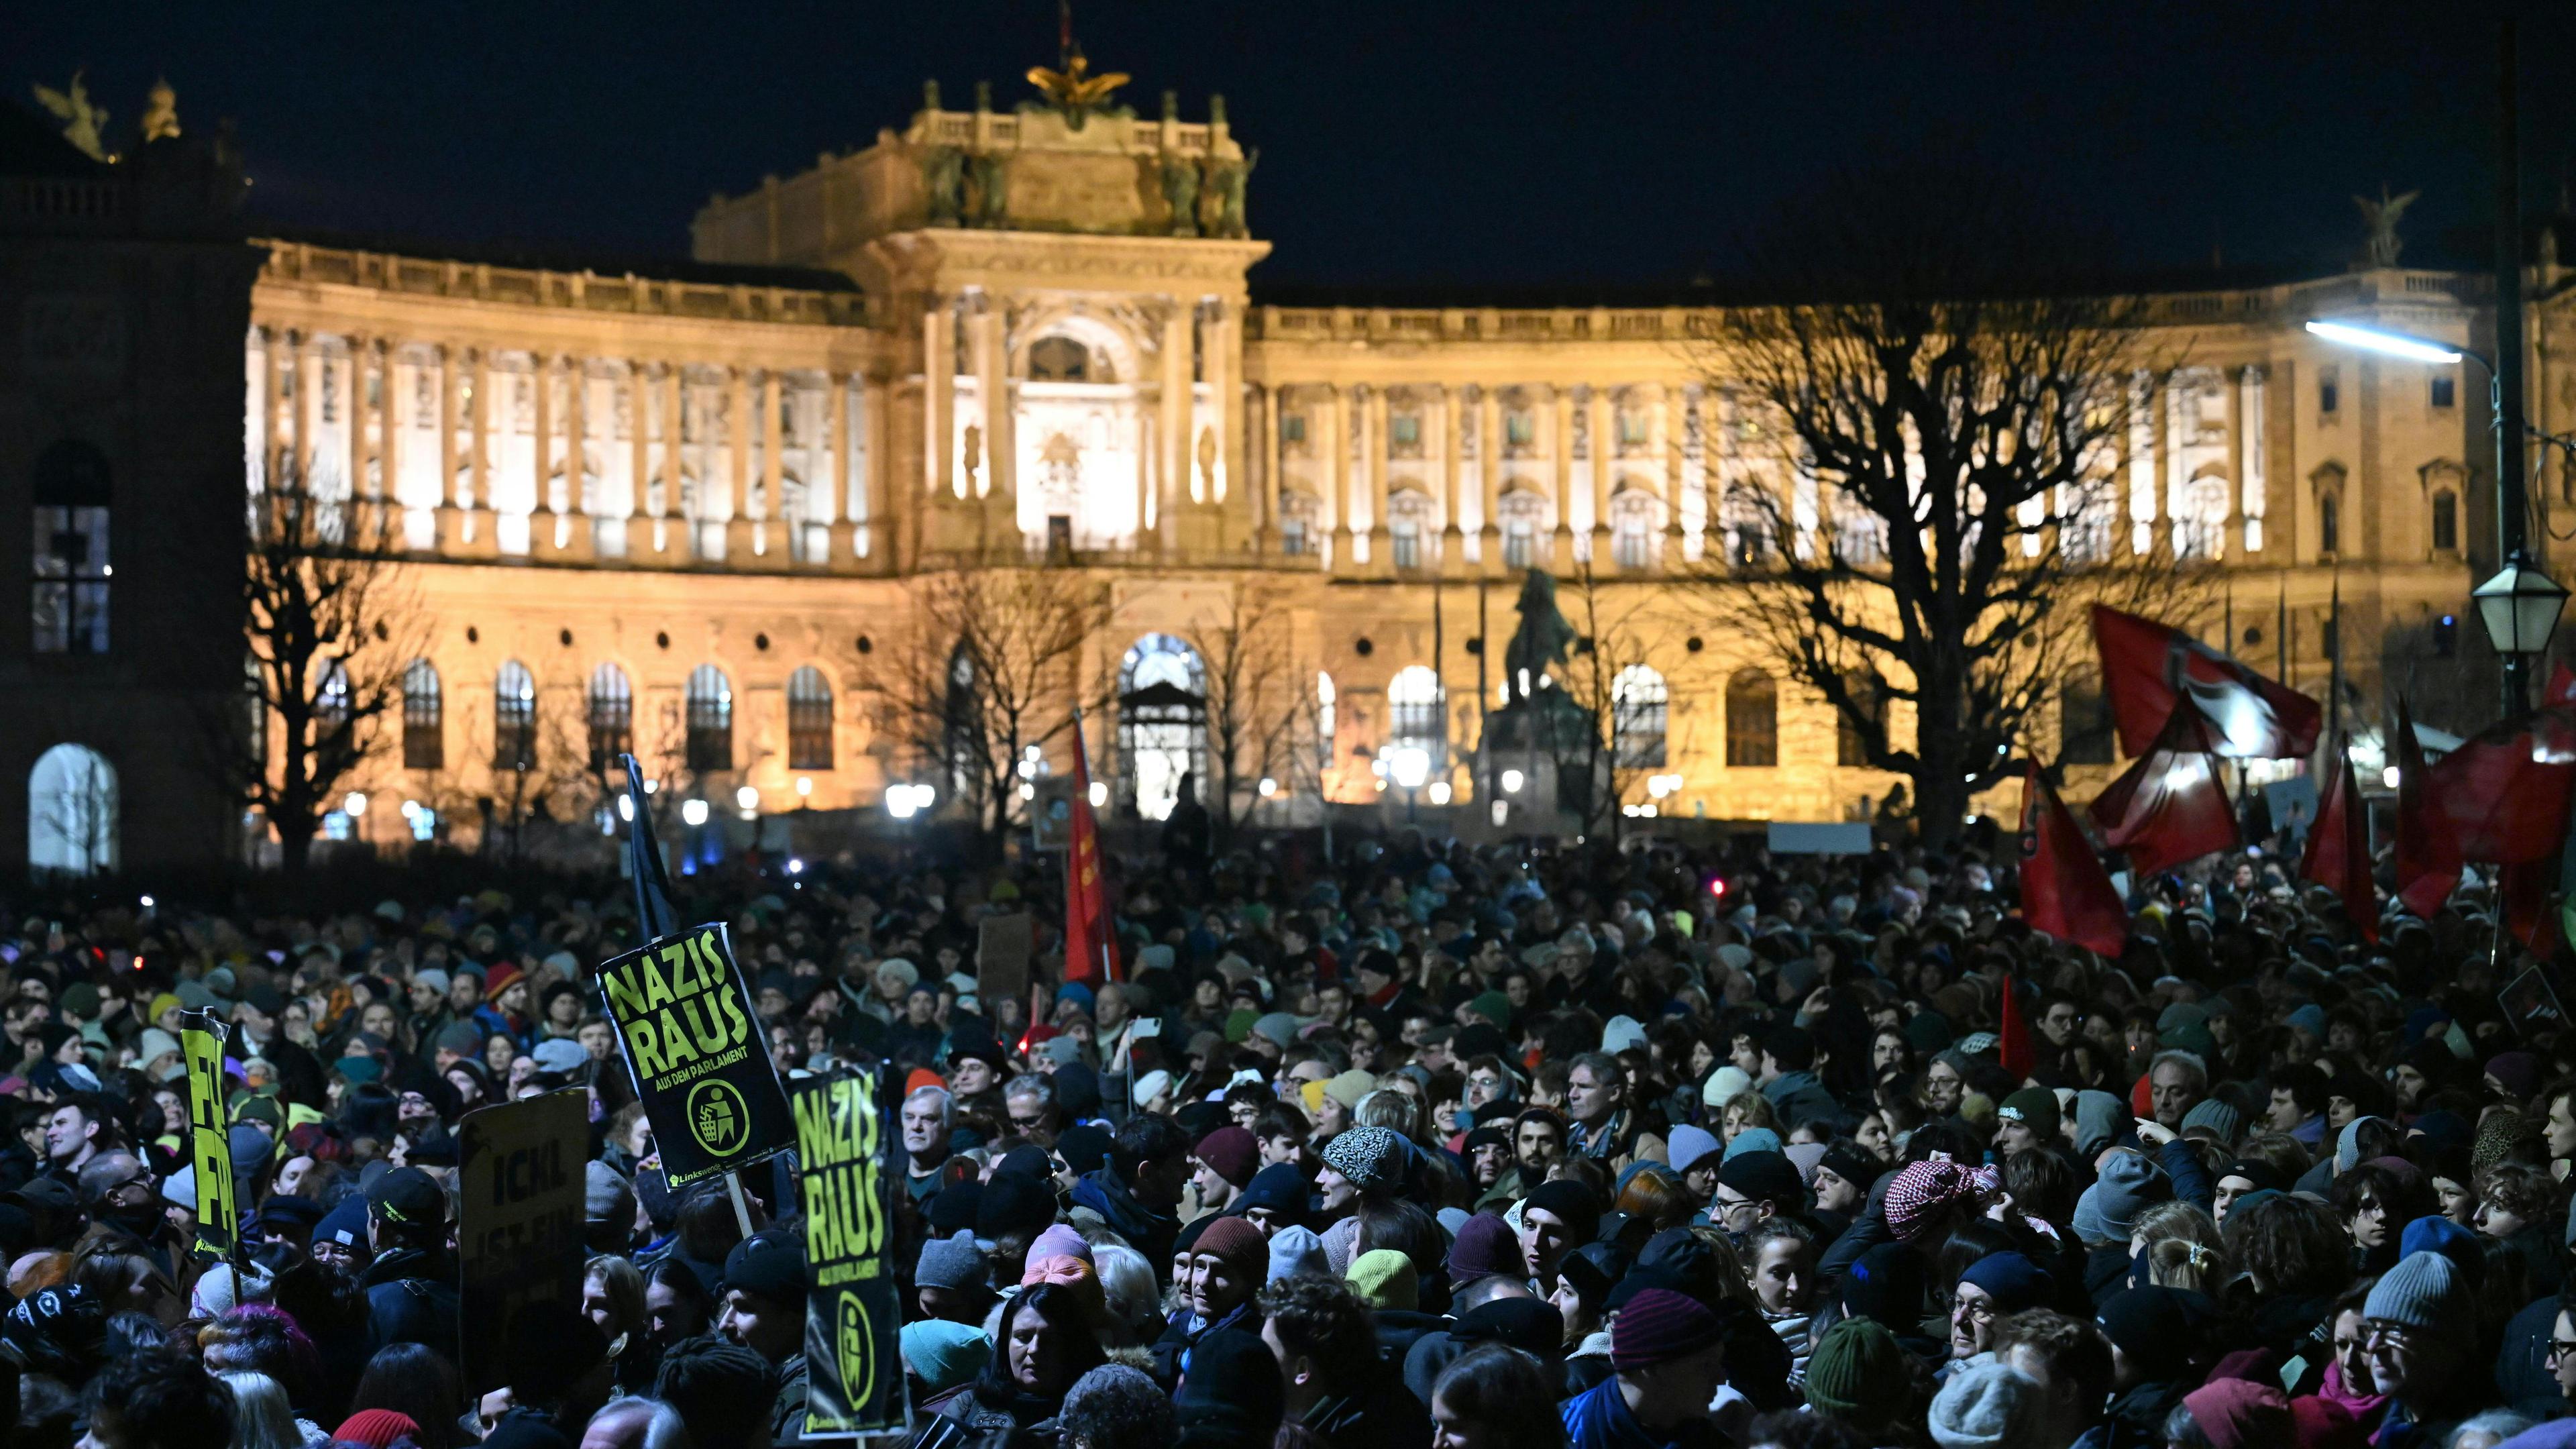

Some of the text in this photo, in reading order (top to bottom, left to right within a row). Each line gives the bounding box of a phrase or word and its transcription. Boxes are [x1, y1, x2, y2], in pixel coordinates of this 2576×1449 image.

[604, 929, 725, 1022] NAZIS
[625, 983, 748, 1079] RAUS
[655, 1046, 748, 1092] AUS DEM PARLAMENT
[793, 1071, 877, 1171] NAZIS
[679, 1162, 721, 1183] Linkswende
[803, 1159, 883, 1263] RAUS
